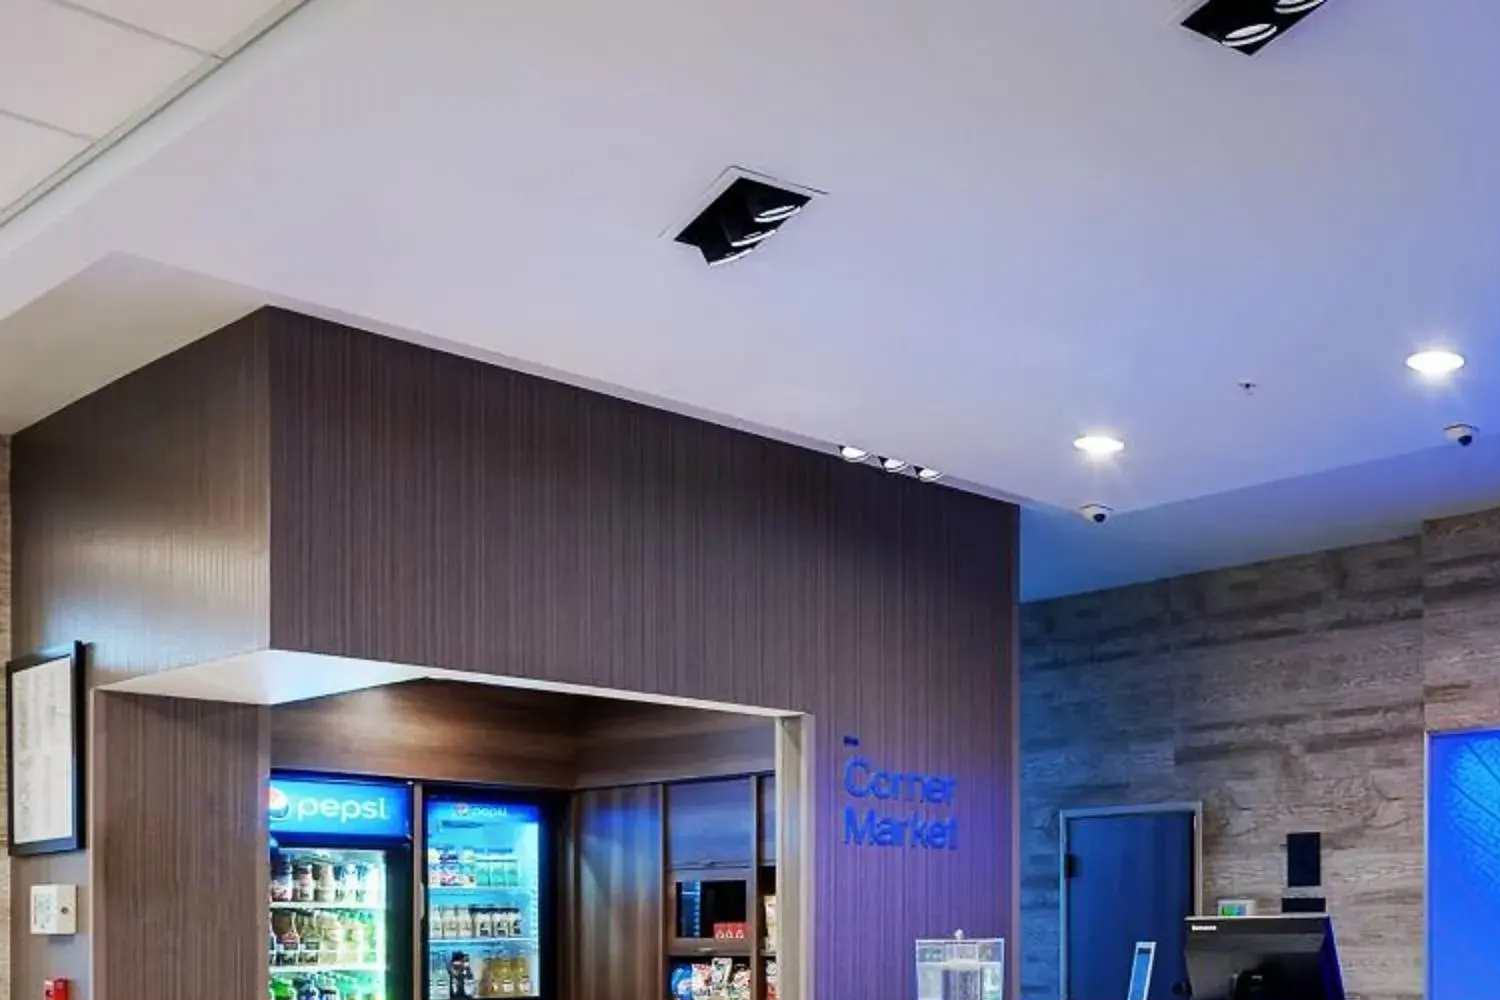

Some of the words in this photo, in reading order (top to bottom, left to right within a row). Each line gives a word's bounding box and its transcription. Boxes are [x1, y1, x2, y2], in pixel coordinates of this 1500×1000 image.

[844, 756, 957, 804] Corner
[298, 797, 387, 823] pepsi
[844, 803, 957, 849] Market
